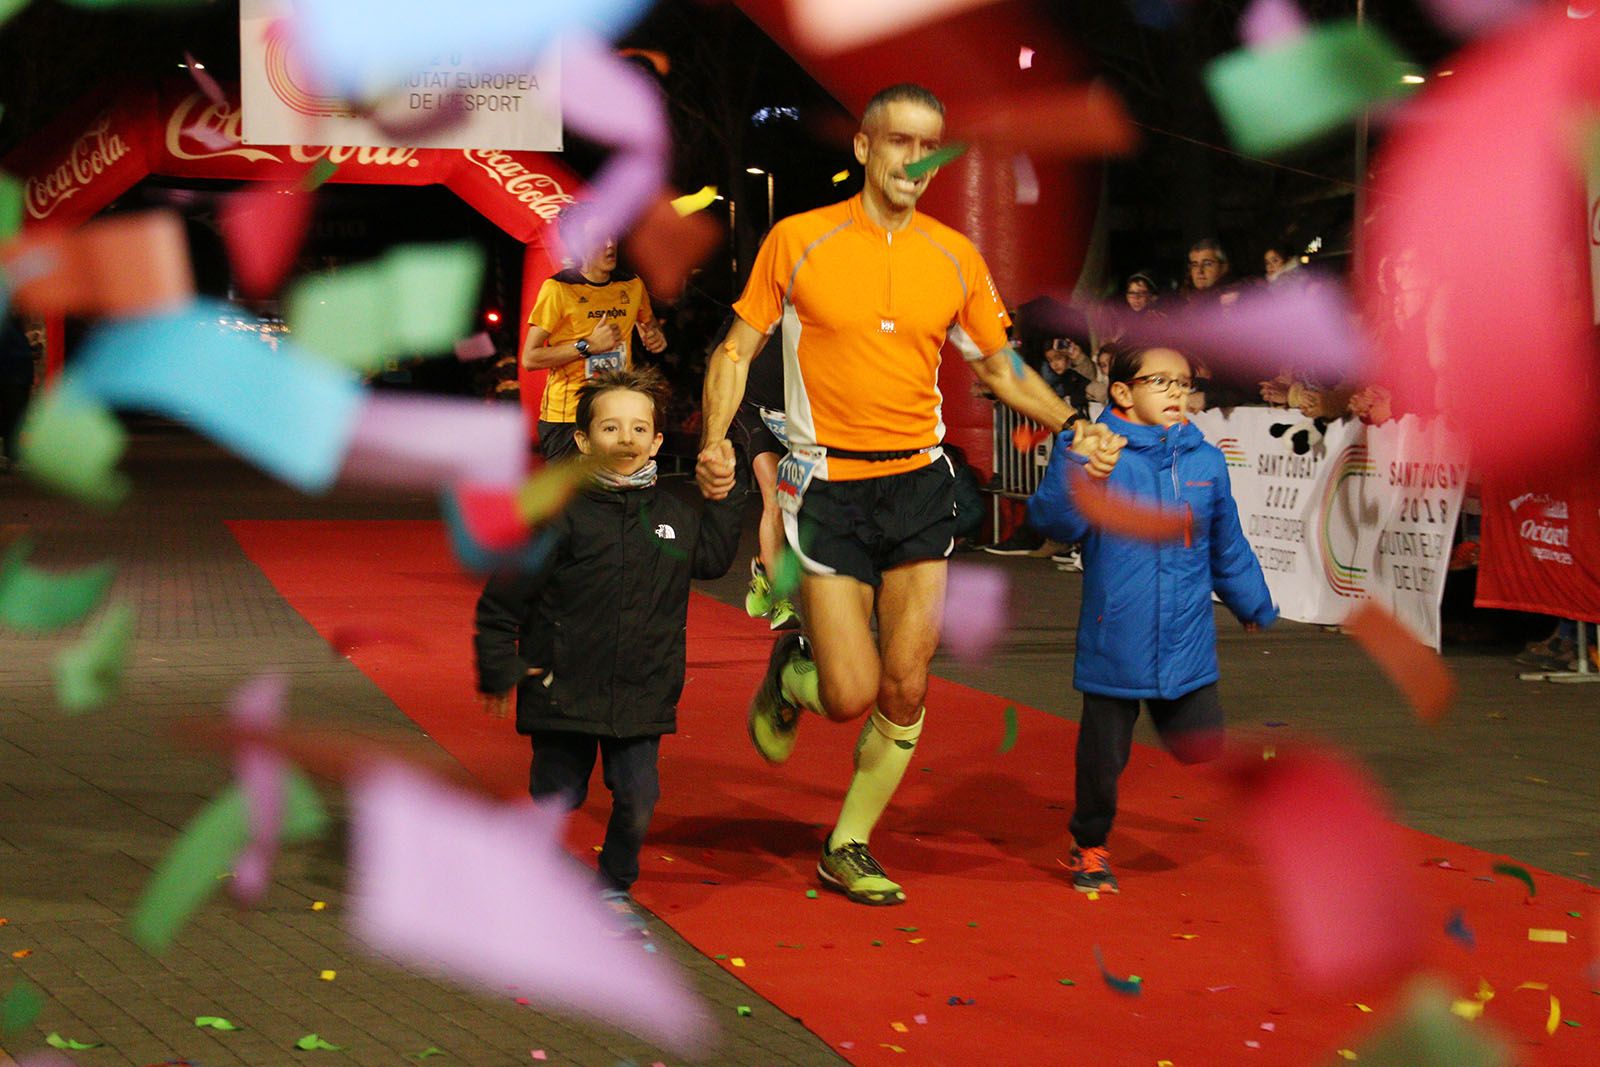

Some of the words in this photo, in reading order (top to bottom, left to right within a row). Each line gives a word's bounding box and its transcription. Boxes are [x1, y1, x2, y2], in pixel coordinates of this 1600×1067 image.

[456, 72, 540, 91] EUROPEA
[410, 93, 433, 110] DE
[25, 119, 131, 219] Coca-Cola
[1258, 454, 1284, 476] SANT
[1285, 457, 1318, 480] CUGAT
[1389, 461, 1420, 489] SANT
[1266, 486, 1299, 510] 2018
